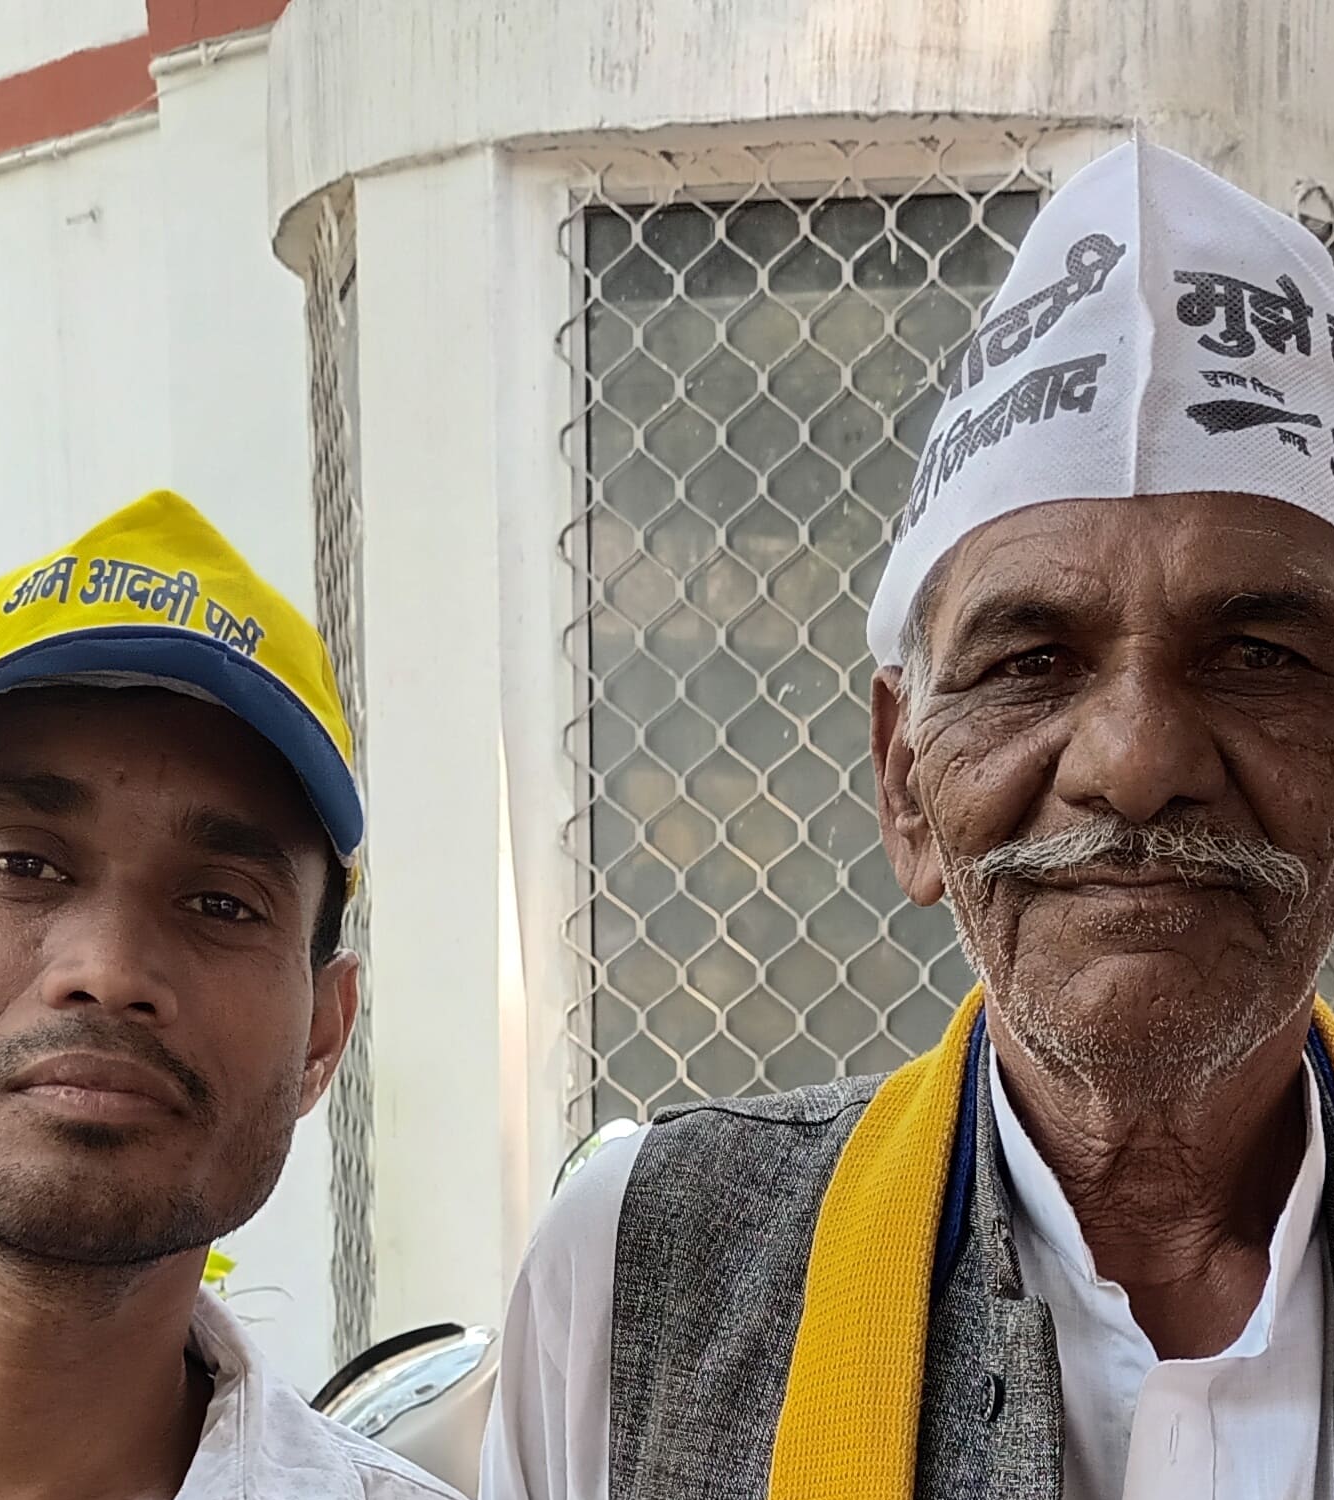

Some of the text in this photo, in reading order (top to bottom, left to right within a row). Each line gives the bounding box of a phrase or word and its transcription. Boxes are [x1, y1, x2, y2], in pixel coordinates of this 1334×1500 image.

[1173, 270, 1313, 357] मुझे
[3, 556, 78, 614] आम
[80, 559, 200, 626] आदमी
